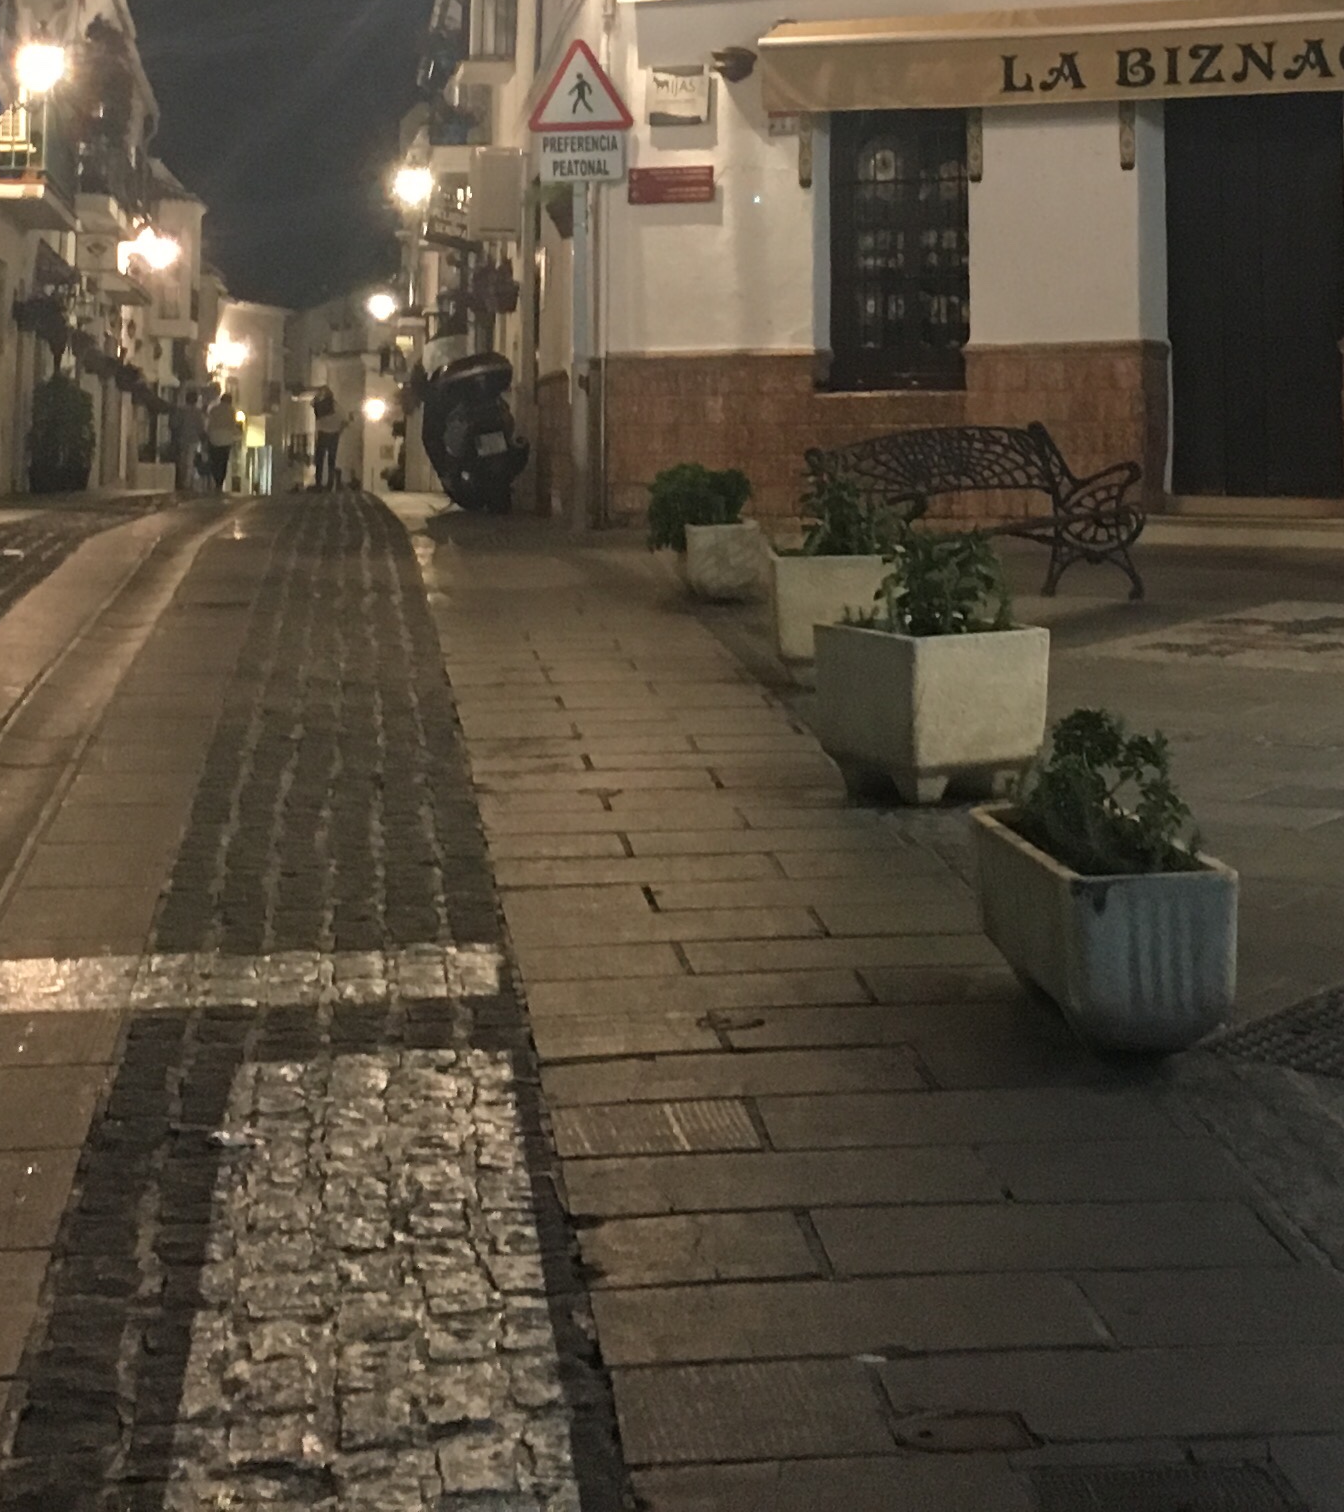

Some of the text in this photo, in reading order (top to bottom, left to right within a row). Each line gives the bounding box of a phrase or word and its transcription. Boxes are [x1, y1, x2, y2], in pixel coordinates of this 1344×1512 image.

[1001, 51, 1087, 94] LA
[542, 134, 619, 154] PREFERENCIA
[552, 159, 610, 177] PEATONAL
